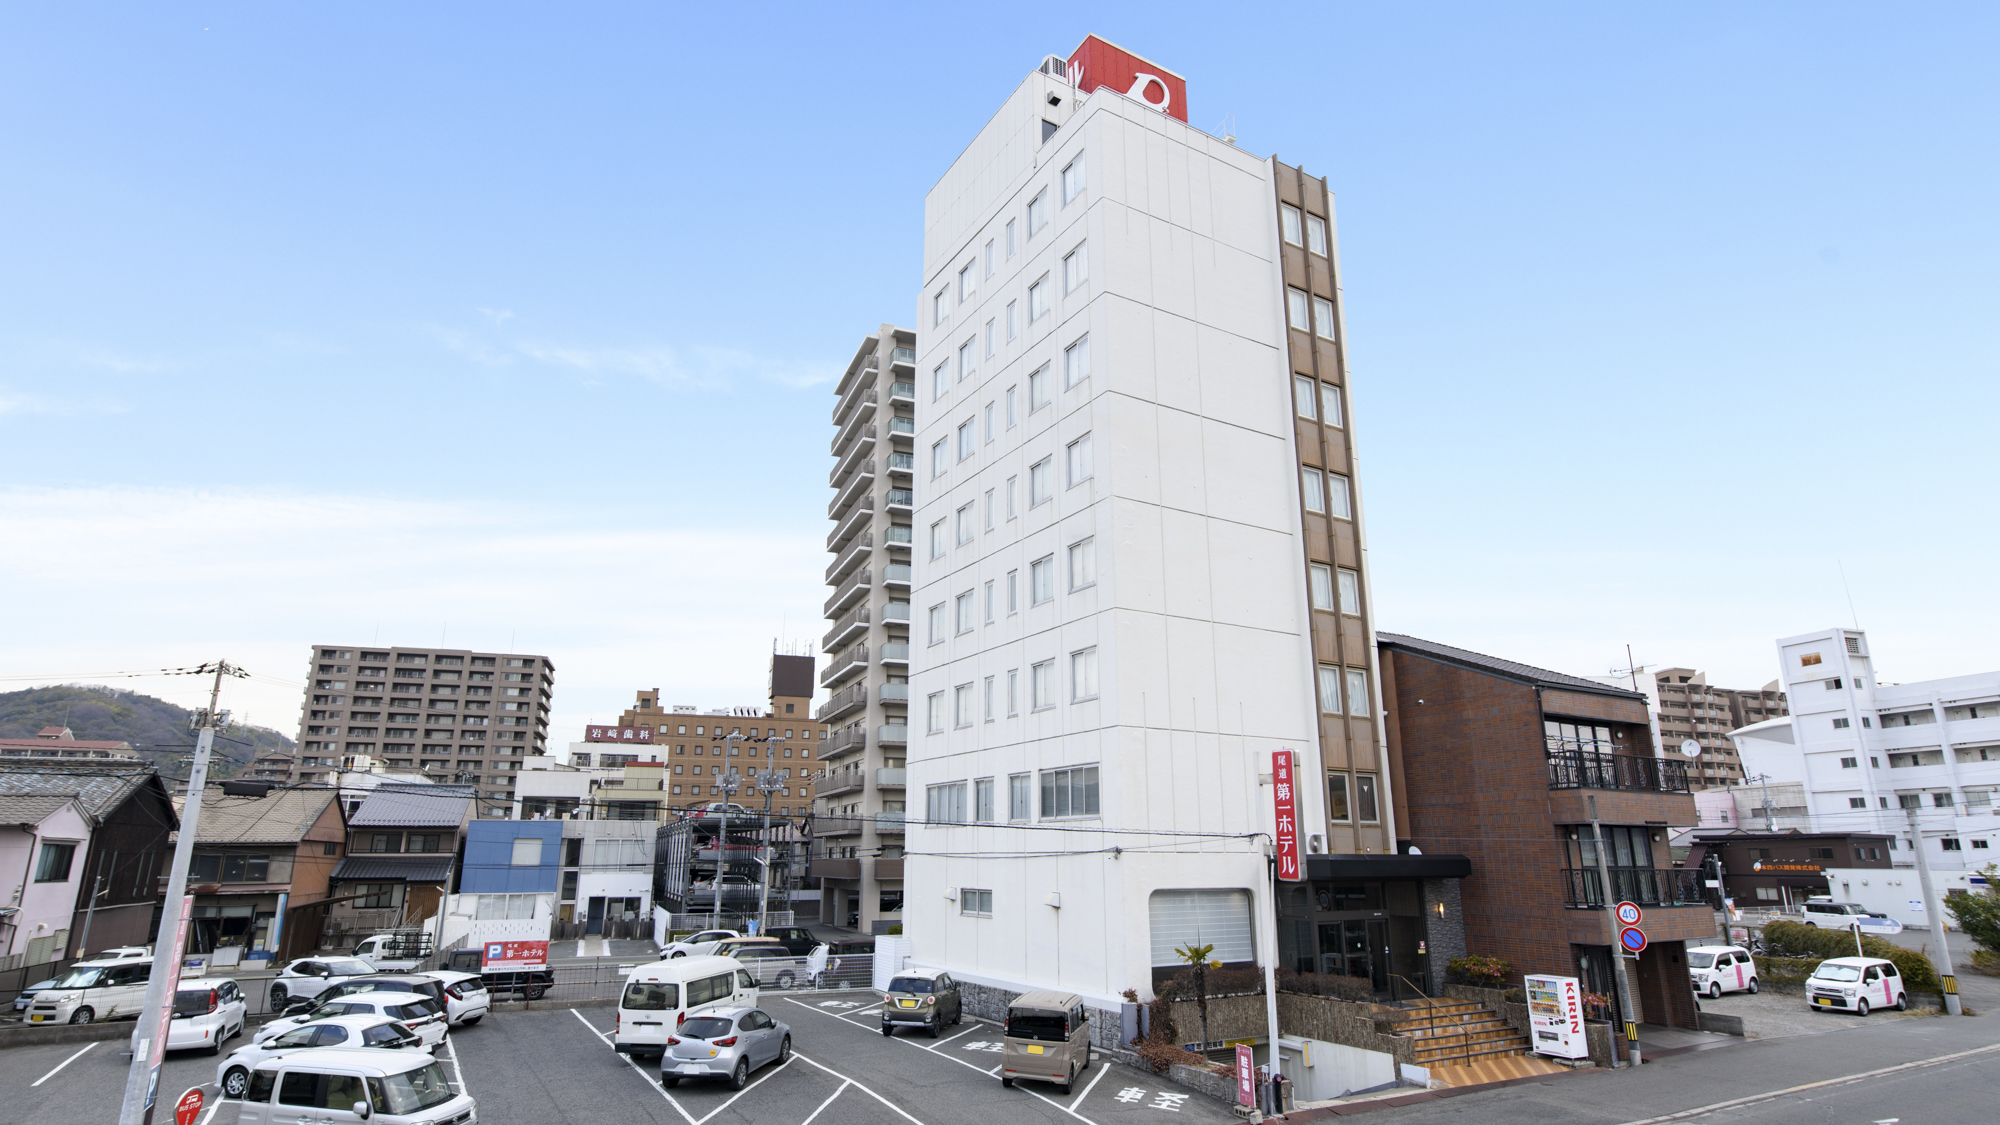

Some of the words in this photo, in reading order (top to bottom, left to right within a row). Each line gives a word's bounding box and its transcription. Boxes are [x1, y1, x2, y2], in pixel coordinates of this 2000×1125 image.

[1622, 908, 1637, 920] 40
[488, 945, 502, 958] P
[506, 949, 544, 958] 第一ホテル
[1565, 982, 1580, 1034] KIRIN
[1241, 1055, 1250, 1092] 駐車場
[145, 1071, 157, 1106] P
[178, 1104, 189, 1112] BUS
[189, 1101, 202, 1110] STOP
